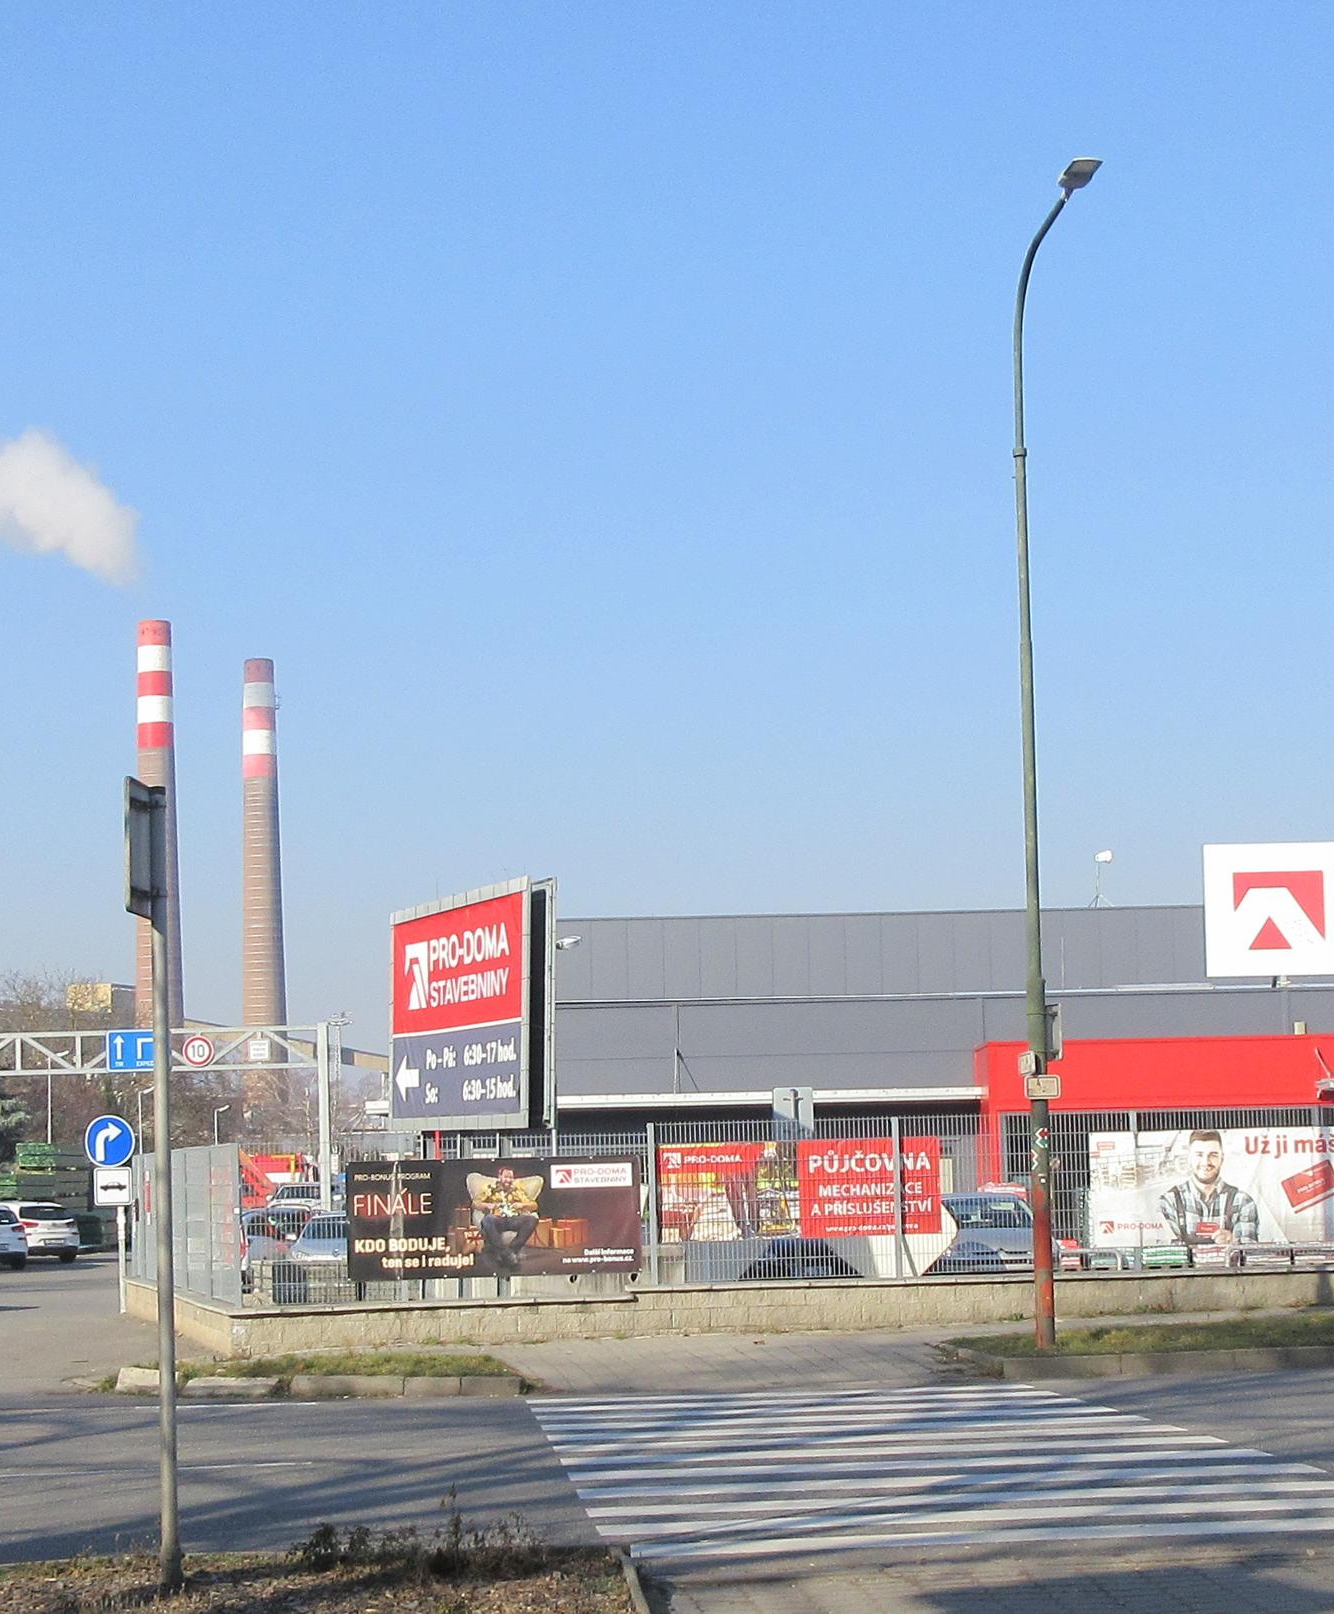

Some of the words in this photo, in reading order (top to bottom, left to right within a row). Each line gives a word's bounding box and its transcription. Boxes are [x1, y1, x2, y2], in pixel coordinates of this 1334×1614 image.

[429, 922, 510, 972] PRO-DOMA
[429, 967, 510, 1008] STAVEBNINY
[191, 1044, 205, 1058] 10
[463, 1041, 497, 1067] 6:30-17
[497, 1037, 517, 1063] hod.
[425, 1082, 439, 1104] So:
[462, 1077, 496, 1102] 6:30-15
[496, 1073, 517, 1099] hod.
[1244, 1135, 1271, 1155] Už
[1274, 1134, 1288, 1159] ji
[683, 1153, 743, 1165] PRO-DOMA
[354, 1173, 395, 1182] PRO-BONUS
[397, 1172, 431, 1181] PROGRAM
[573, 1167, 627, 1176] PRO-DOMA
[818, 1181, 923, 1198] MECHANIZCE
[353, 1187, 433, 1217] FINÁLE
[810, 1203, 821, 1217] A
[1117, 1222, 1163, 1230] PRO-DOMA
[354, 1239, 386, 1254] KDO
[388, 1237, 451, 1253] BODUJE,
[601, 1247, 635, 1255] informace
[381, 1256, 403, 1269] ten
[404, 1258, 420, 1268] se
[421, 1254, 427, 1268] i
[428, 1253, 475, 1270] raduje!
